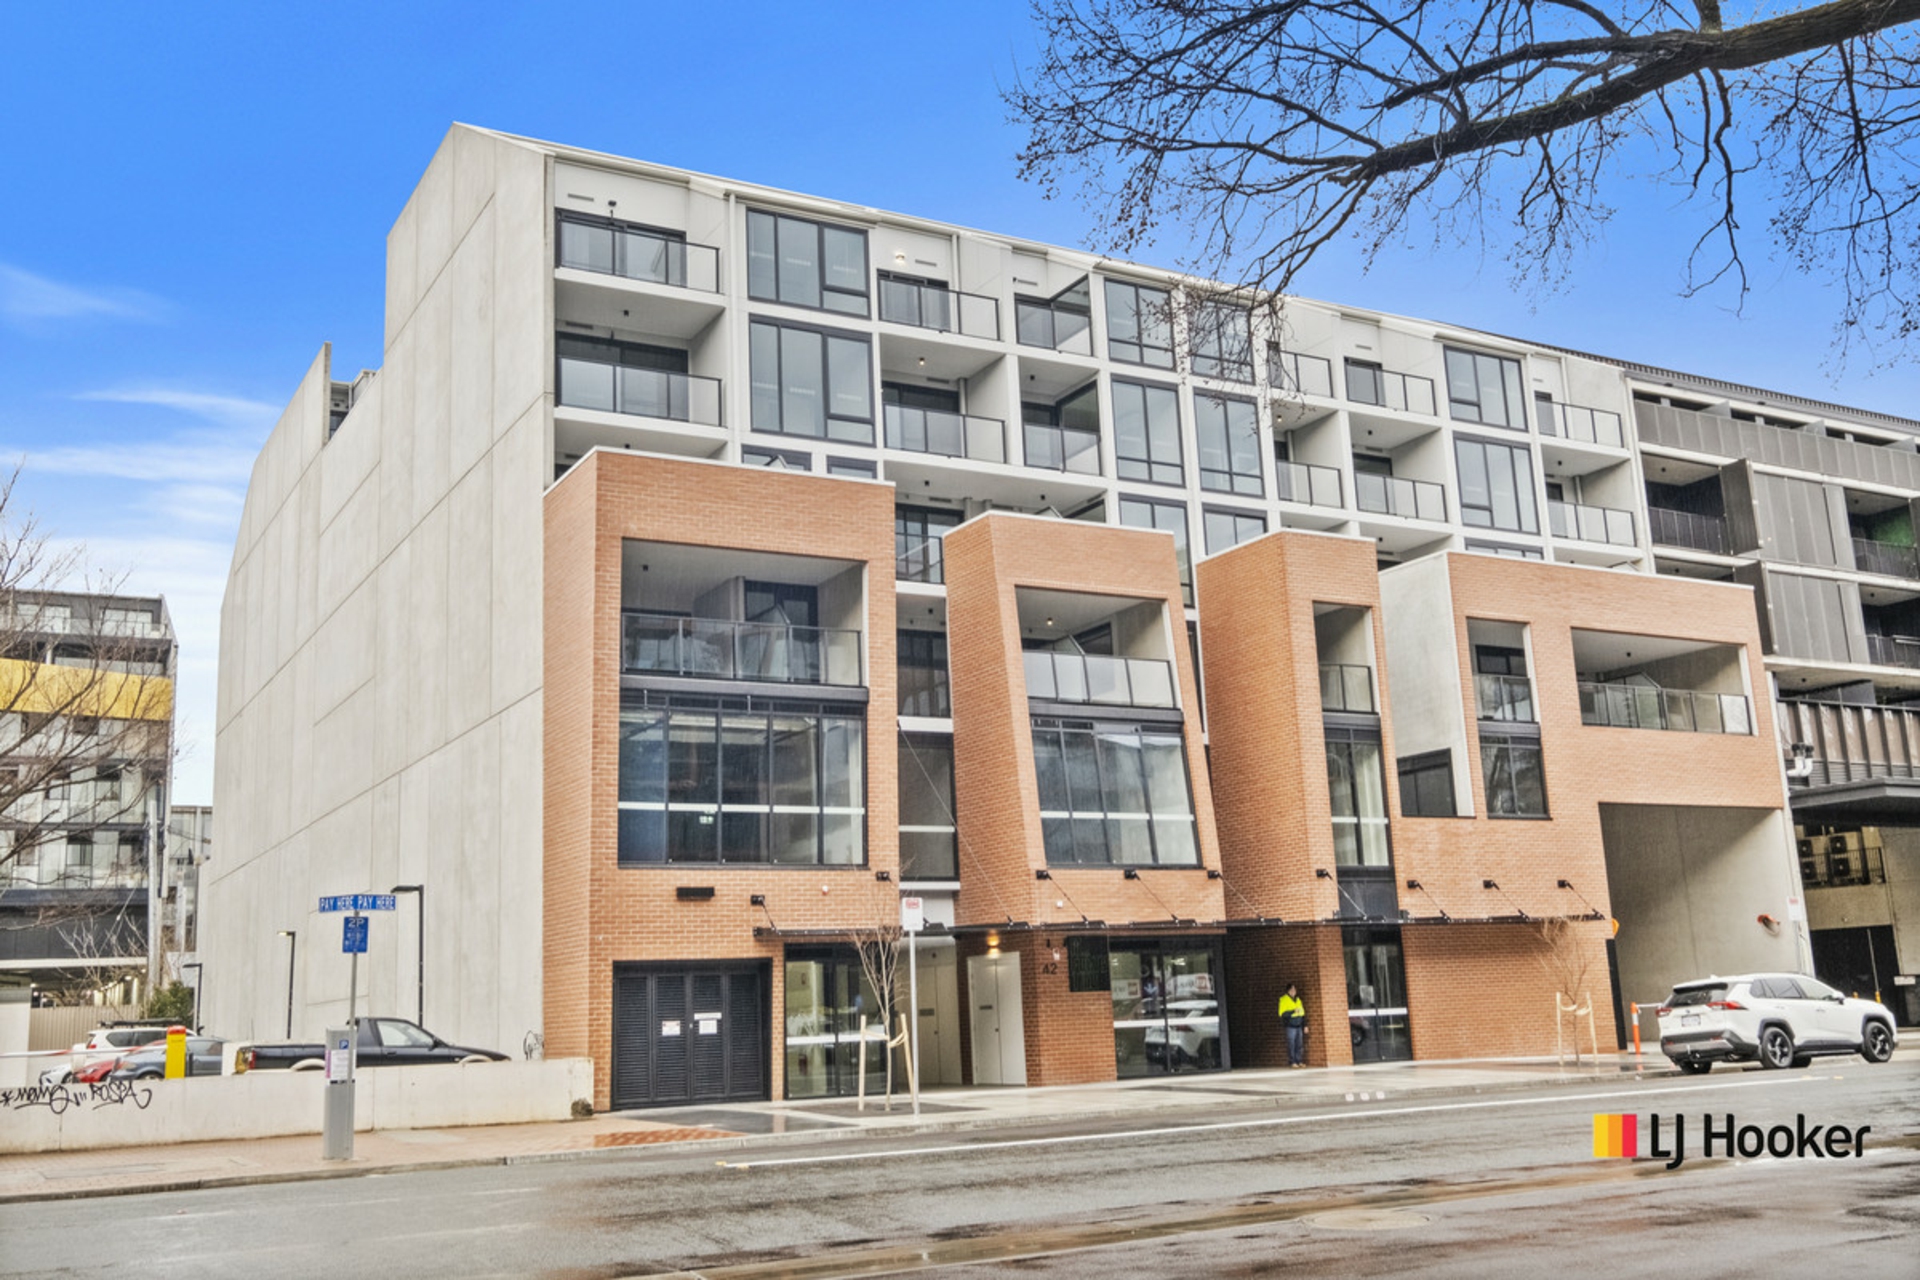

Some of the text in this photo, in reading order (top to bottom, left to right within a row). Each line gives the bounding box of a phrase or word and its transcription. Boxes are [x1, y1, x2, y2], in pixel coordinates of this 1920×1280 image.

[320, 895, 355, 911] PAY HERE
[358, 895, 395, 909] PAY HERE
[348, 918, 365, 928] 2P
[1042, 962, 1058, 975] 42
